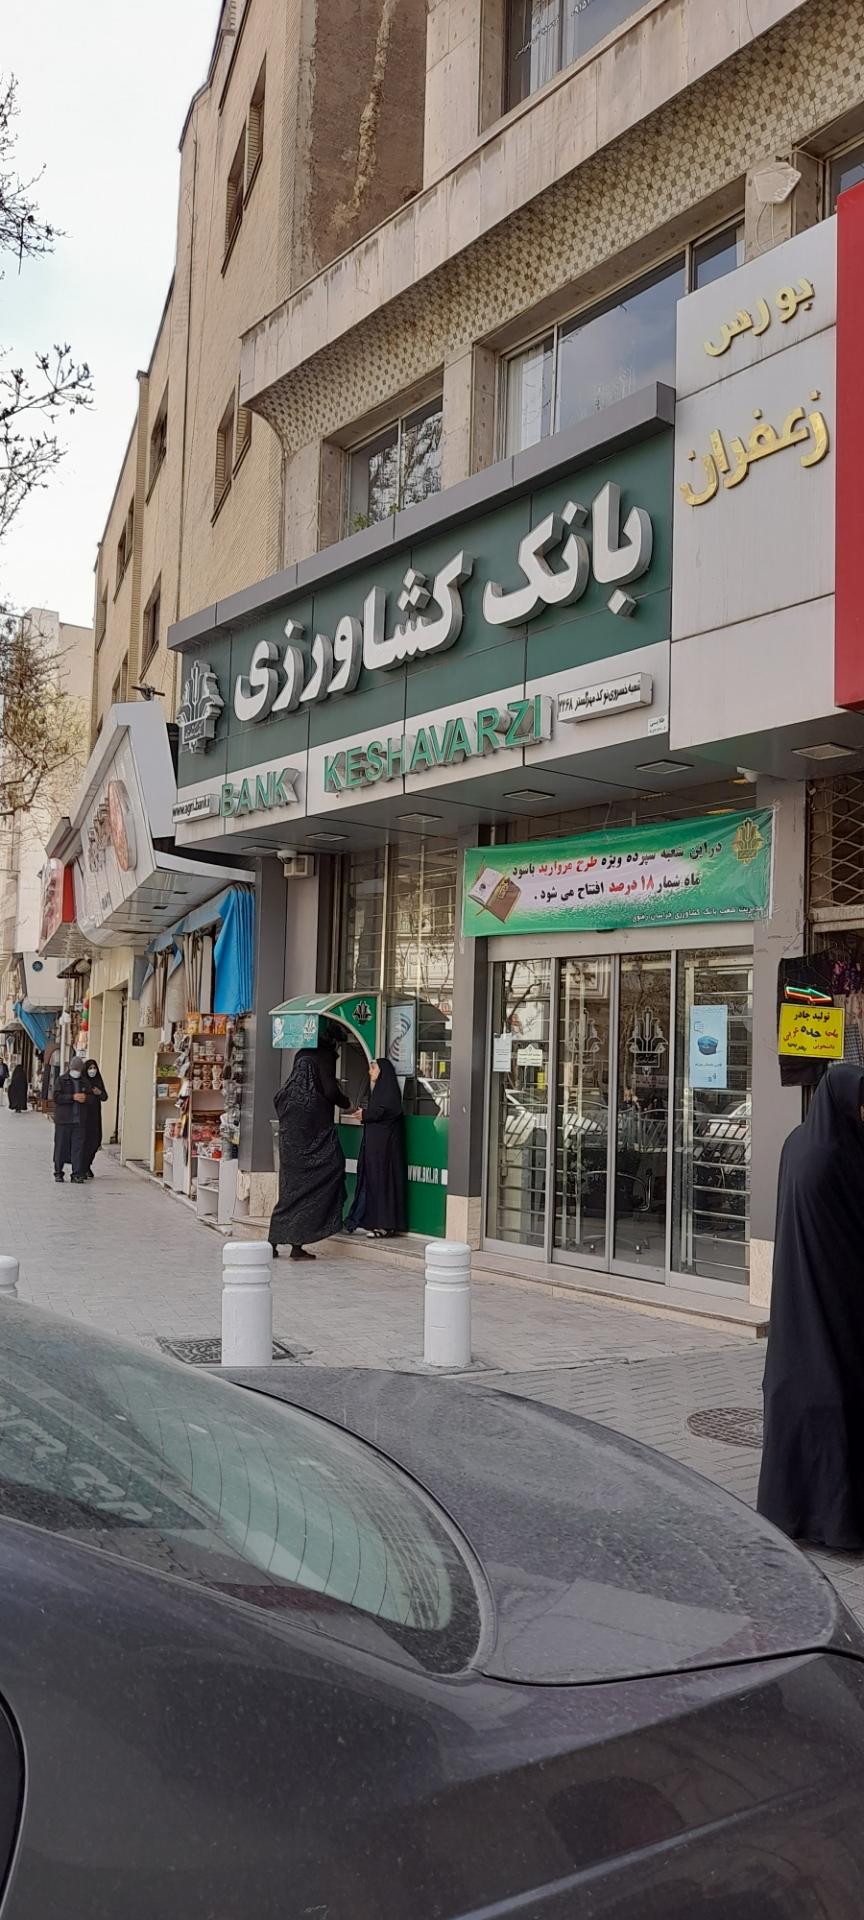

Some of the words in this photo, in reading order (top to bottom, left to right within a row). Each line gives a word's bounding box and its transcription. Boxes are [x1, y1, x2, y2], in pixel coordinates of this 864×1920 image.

[704, 277, 815, 357] بورس
[680, 389, 830, 506] زعفران
[483, 481, 653, 627] بانک
[233, 549, 475, 723] کشاورزی
[220, 768, 299, 818] BANK
[324, 693, 553, 793] KESHAVARZI
[626, 852, 656, 866] سپرده
[661, 846, 684, 862] شعبه
[538, 860, 572, 876] مروارید
[576, 856, 598, 873] طرح
[601, 856, 622, 869] ویژه
[641, 874, 655, 890] ۱۸
[657, 874, 680, 893] شمار
[684, 872, 701, 886] ماه
[561, 889, 574, 901] می
[578, 882, 604, 899] افتتاح
[608, 880, 637, 895] درصد
[813, 1011, 830, 1022] تولید
